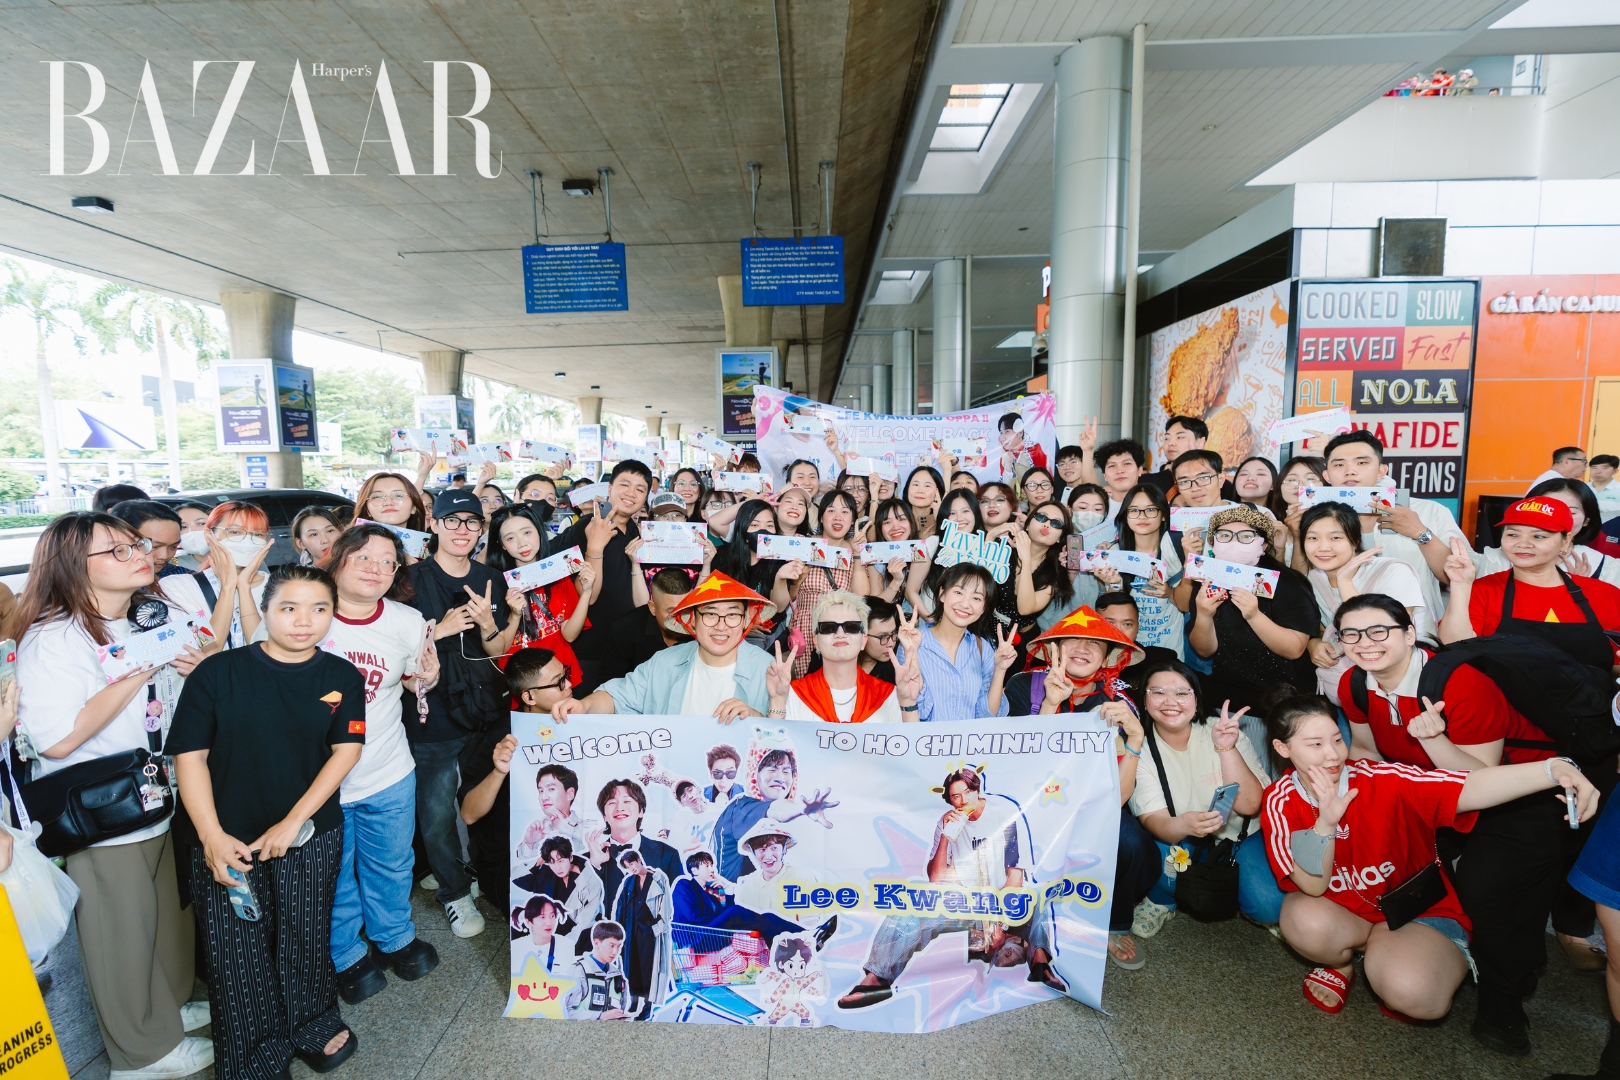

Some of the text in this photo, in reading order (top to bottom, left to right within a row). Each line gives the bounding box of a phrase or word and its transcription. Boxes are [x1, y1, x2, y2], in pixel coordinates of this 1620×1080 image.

[1305, 291, 1399, 320] COOKED
[1301, 331, 1470, 364] SERVED Fast
[1297, 377, 1459, 407] ALL NOLA
[834, 425, 992, 442] WELCOME BACK
[946, 414, 980, 423] OPPA
[1302, 421, 1461, 449] NAFIDE
[343, 651, 390, 673] NWALL
[522, 727, 1111, 765] welcome TO HO CHI MINH CITY
[1328, 861, 1396, 893] didas
[782, 884, 860, 910] Lee
[873, 882, 1033, 920] Kwang
[0, 1021, 44, 1058] ANING
[0, 1033, 53, 1076] ROGRESS
